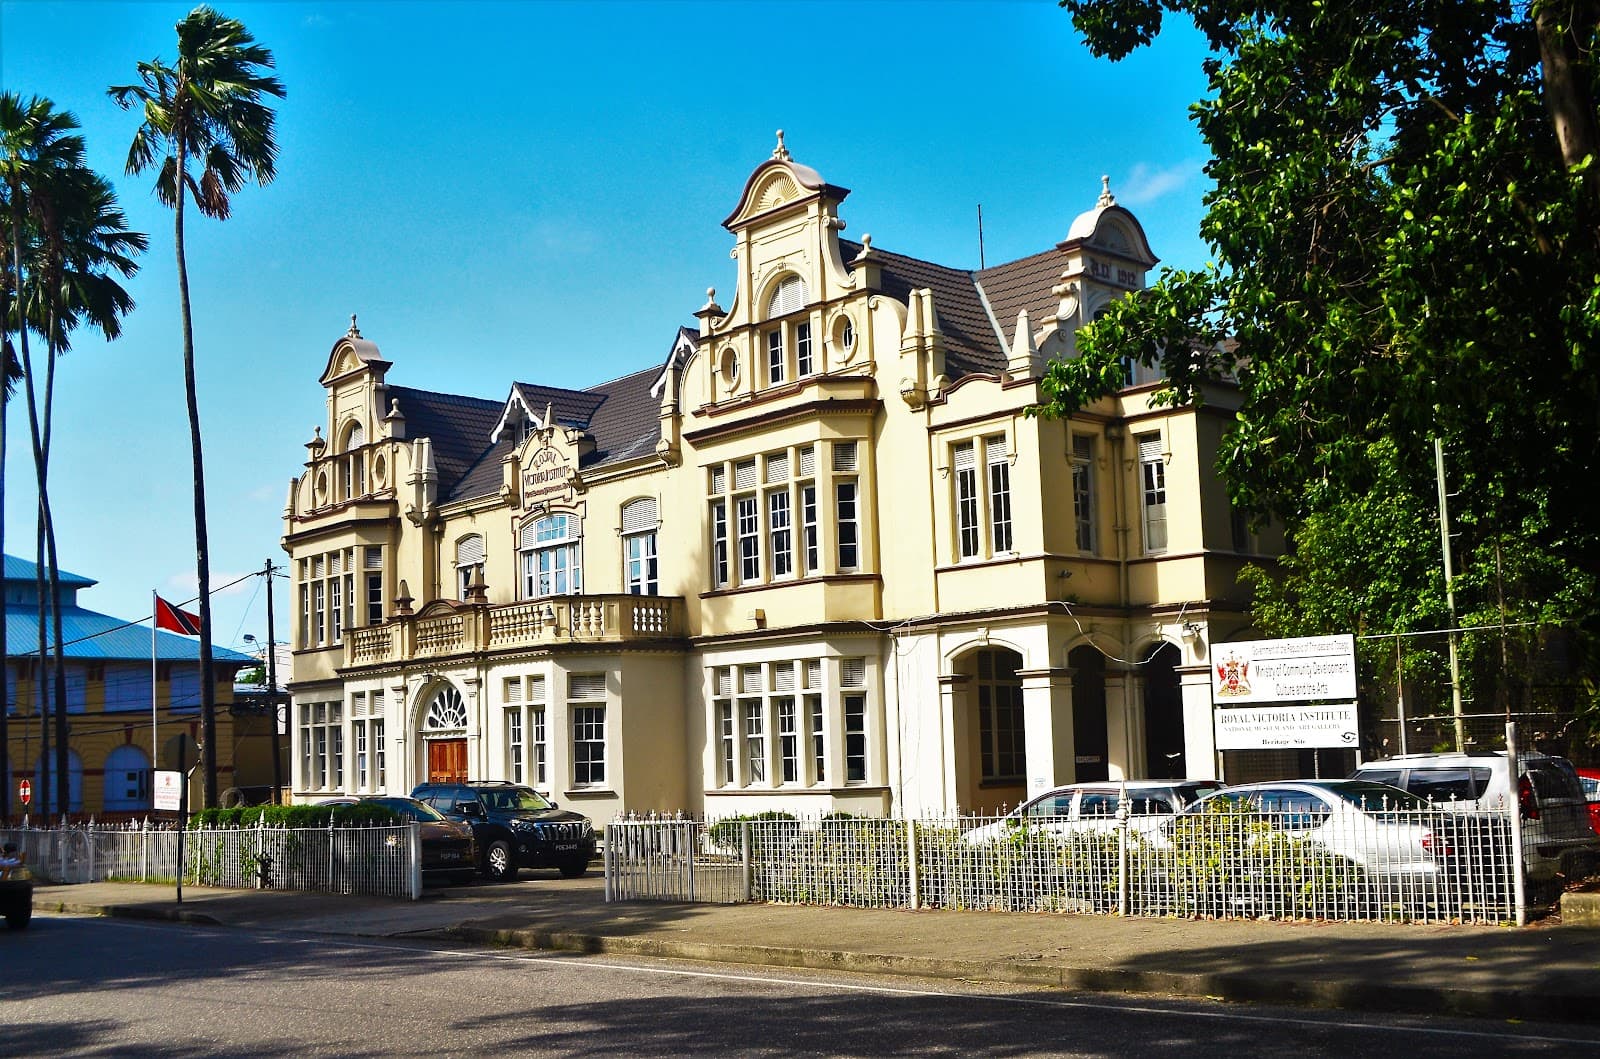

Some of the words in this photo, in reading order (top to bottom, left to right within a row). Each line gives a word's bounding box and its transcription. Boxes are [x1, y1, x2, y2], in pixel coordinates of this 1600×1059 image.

[533, 451, 557, 470] ROYAL
[525, 472, 545, 486] VICTORIA
[1255, 664, 1275, 682] Ministry
[1276, 663, 1281, 677] of
[1282, 661, 1311, 680] Community
[1312, 658, 1349, 675] Development
[1275, 681, 1295, 696] Culture
[1295, 682, 1306, 695] and
[1306, 682, 1315, 695] the
[1316, 680, 1328, 694] Arts
[1221, 713, 1251, 724] ROYAL
[1252, 711, 1296, 723] VICTORIA
[1300, 710, 1351, 721] INSTITUTE
